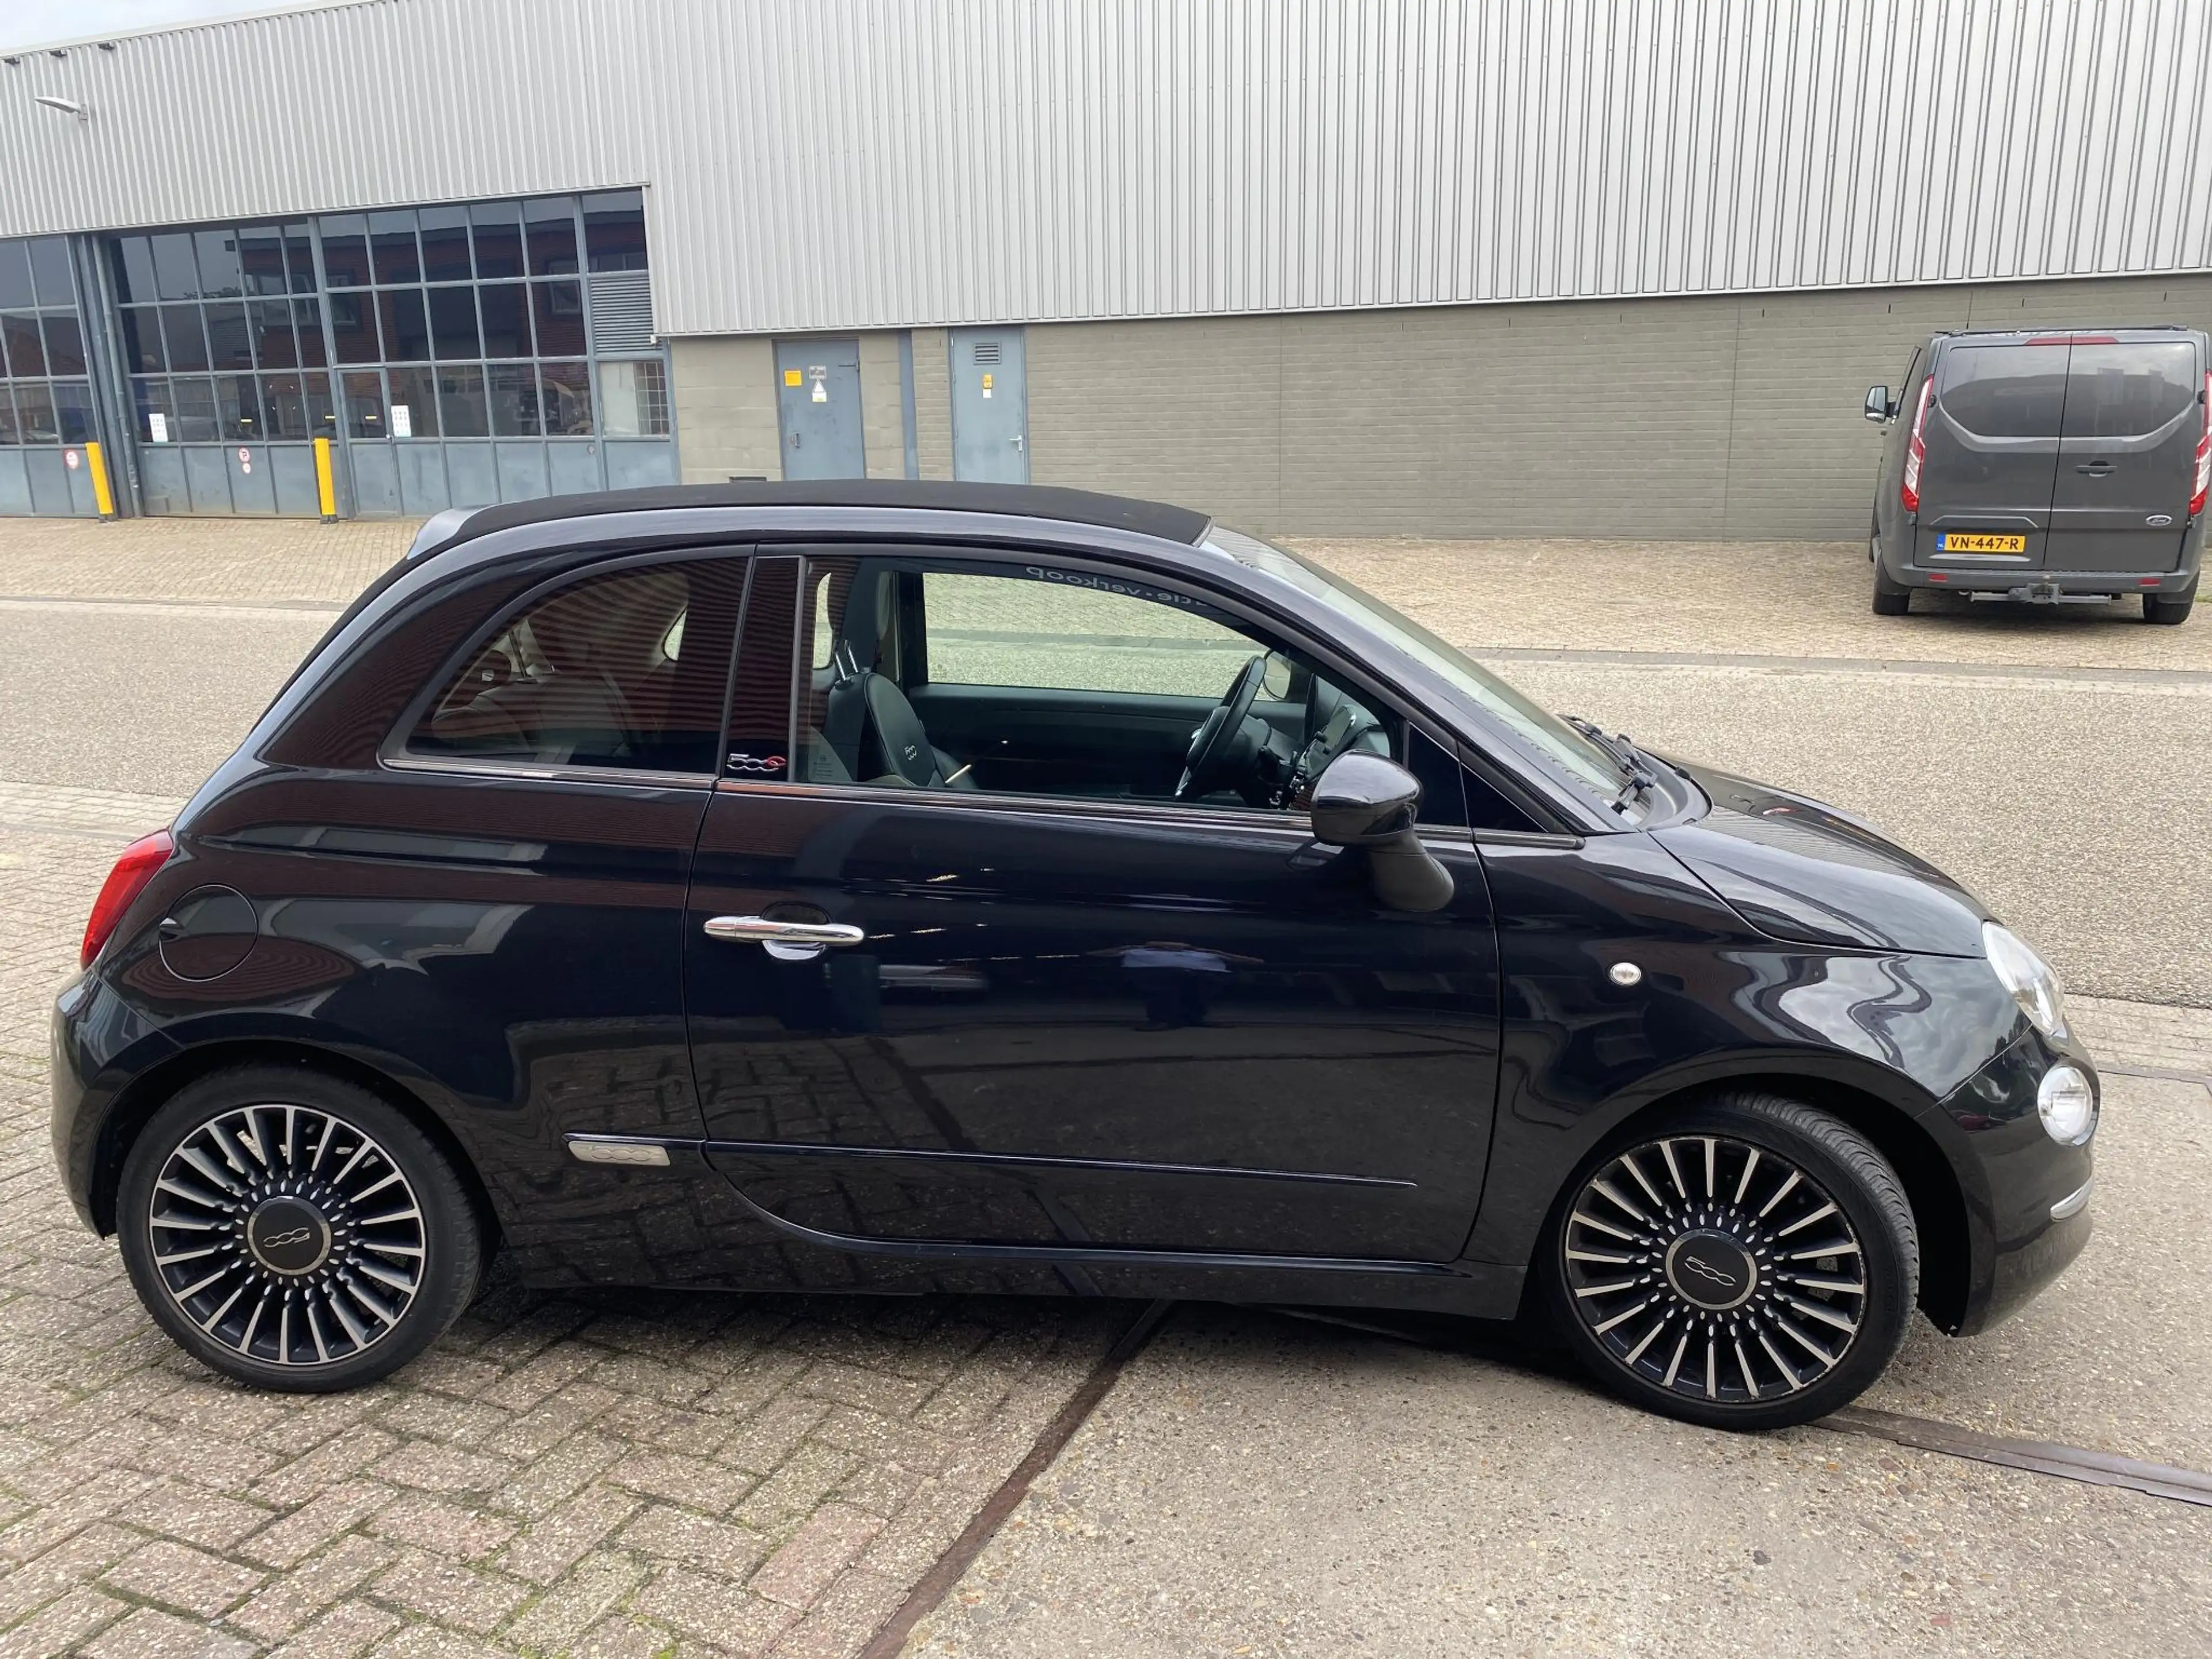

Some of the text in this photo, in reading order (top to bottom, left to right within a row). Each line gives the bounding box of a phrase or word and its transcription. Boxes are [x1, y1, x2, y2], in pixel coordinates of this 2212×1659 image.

[1950, 536, 2018, 550] VN-447-R
[263, 1227, 310, 1248] 500
[1684, 1256, 1736, 1286] 500
